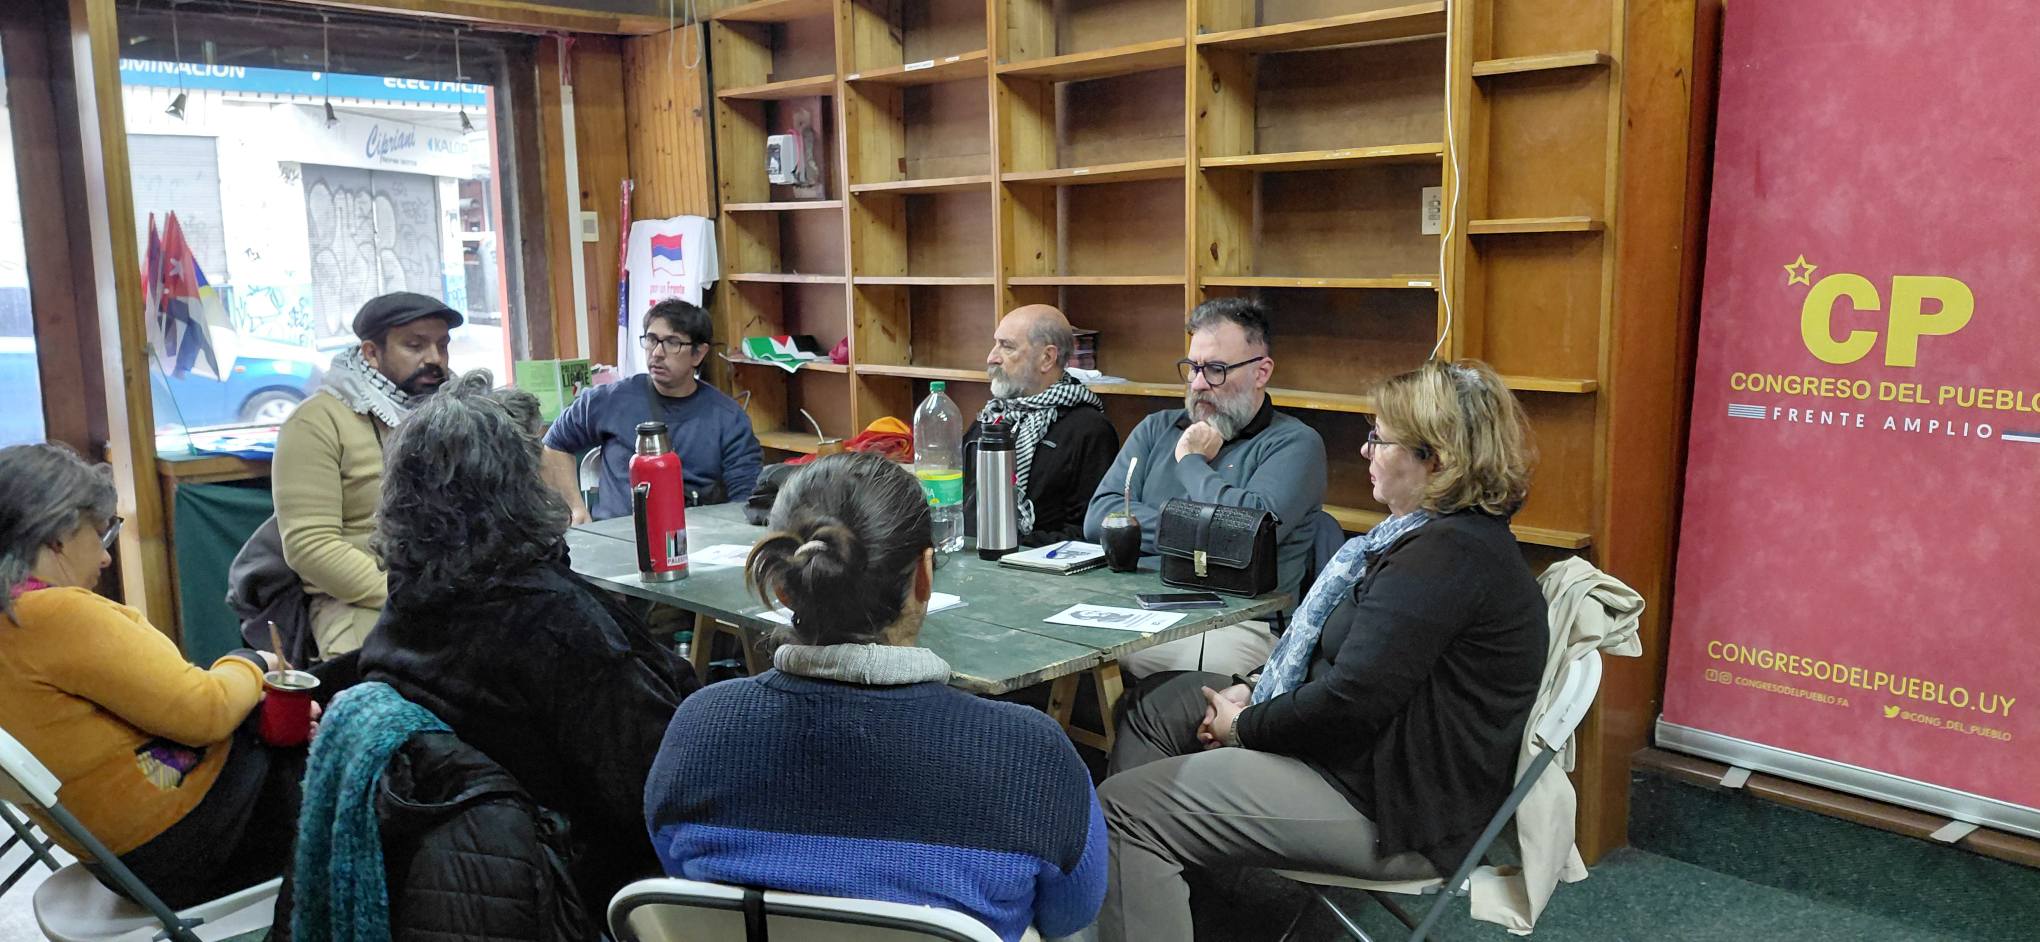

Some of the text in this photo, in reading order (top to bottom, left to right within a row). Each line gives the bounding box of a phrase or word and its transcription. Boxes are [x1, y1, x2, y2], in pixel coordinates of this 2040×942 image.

[1801, 273, 1975, 368] CP
[1730, 371, 1872, 400] CONGRESO
[1878, 381, 1931, 404] DEL
[1773, 406, 1993, 440] FRENTE AMPLIO
[1707, 640, 2016, 717] CONGRESODELPUEBLO.UY
